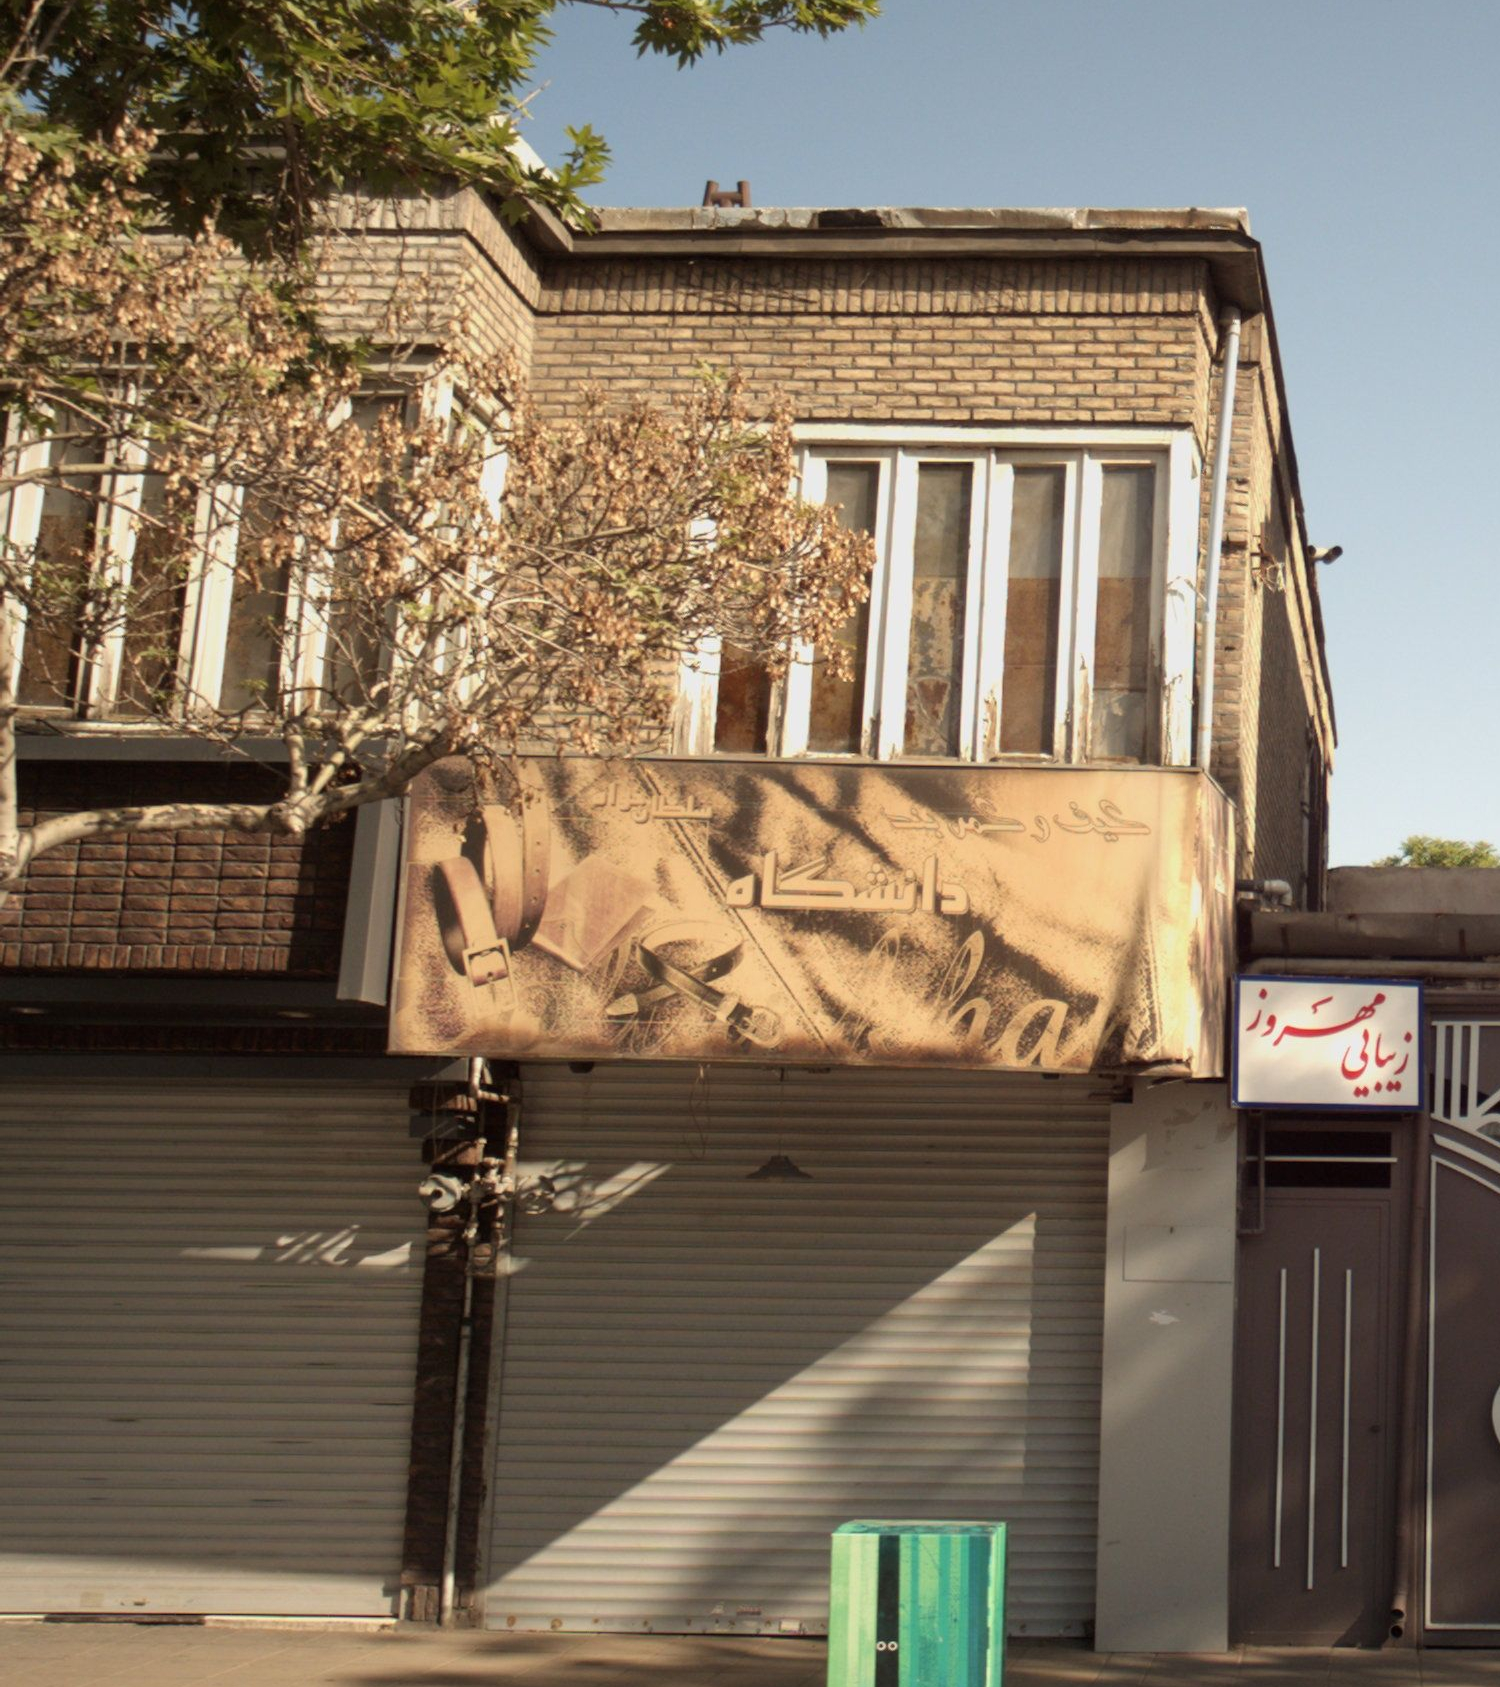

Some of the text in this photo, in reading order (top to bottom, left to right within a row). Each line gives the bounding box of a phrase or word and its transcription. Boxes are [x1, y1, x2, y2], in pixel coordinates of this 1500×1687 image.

[1030, 815, 1051, 843] و
[1053, 799, 1151, 842] کیف
[725, 850, 971, 915] دانشگاه
